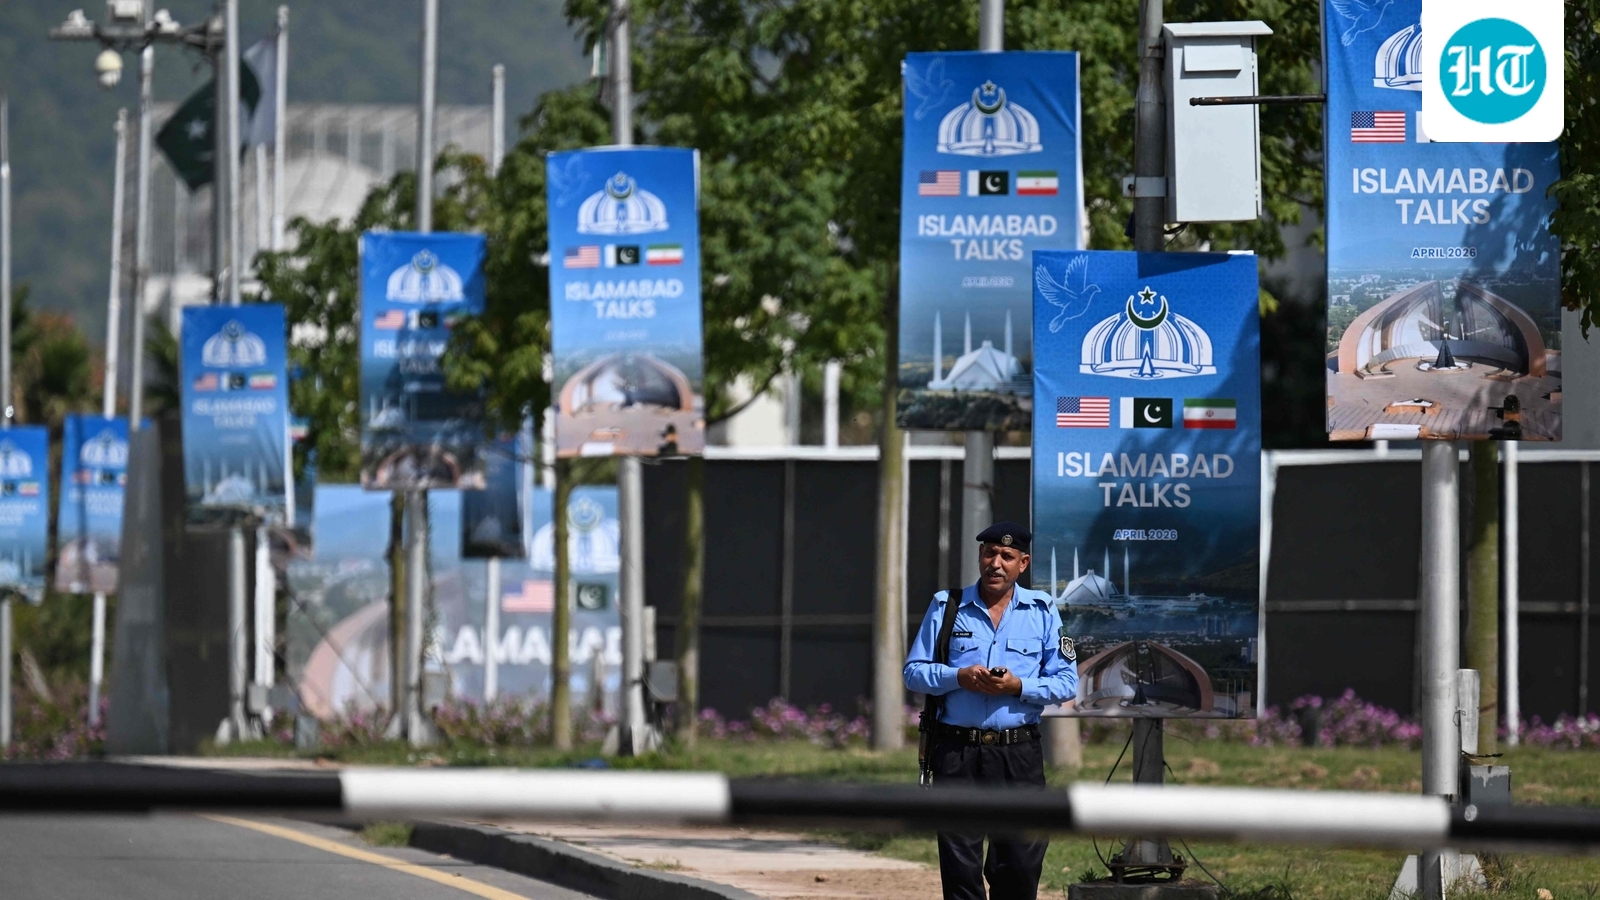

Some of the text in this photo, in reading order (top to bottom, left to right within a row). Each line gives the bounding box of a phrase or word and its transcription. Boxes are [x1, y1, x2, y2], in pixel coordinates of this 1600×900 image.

[1352, 168, 1535, 194] ISLAMABAD
[1395, 199, 1491, 225] TALKS
[918, 214, 1058, 237] ISLAMABAD
[951, 239, 1024, 261] TALKS
[1411, 247, 1477, 258] APRIL 2026
[565, 279, 684, 301] ISLAMABAD
[592, 299, 656, 319] TALKS
[1057, 452, 1234, 478] ISLAMABAD
[1098, 482, 1192, 508] TALKS
[1113, 529, 1178, 541] APRIL 2026
